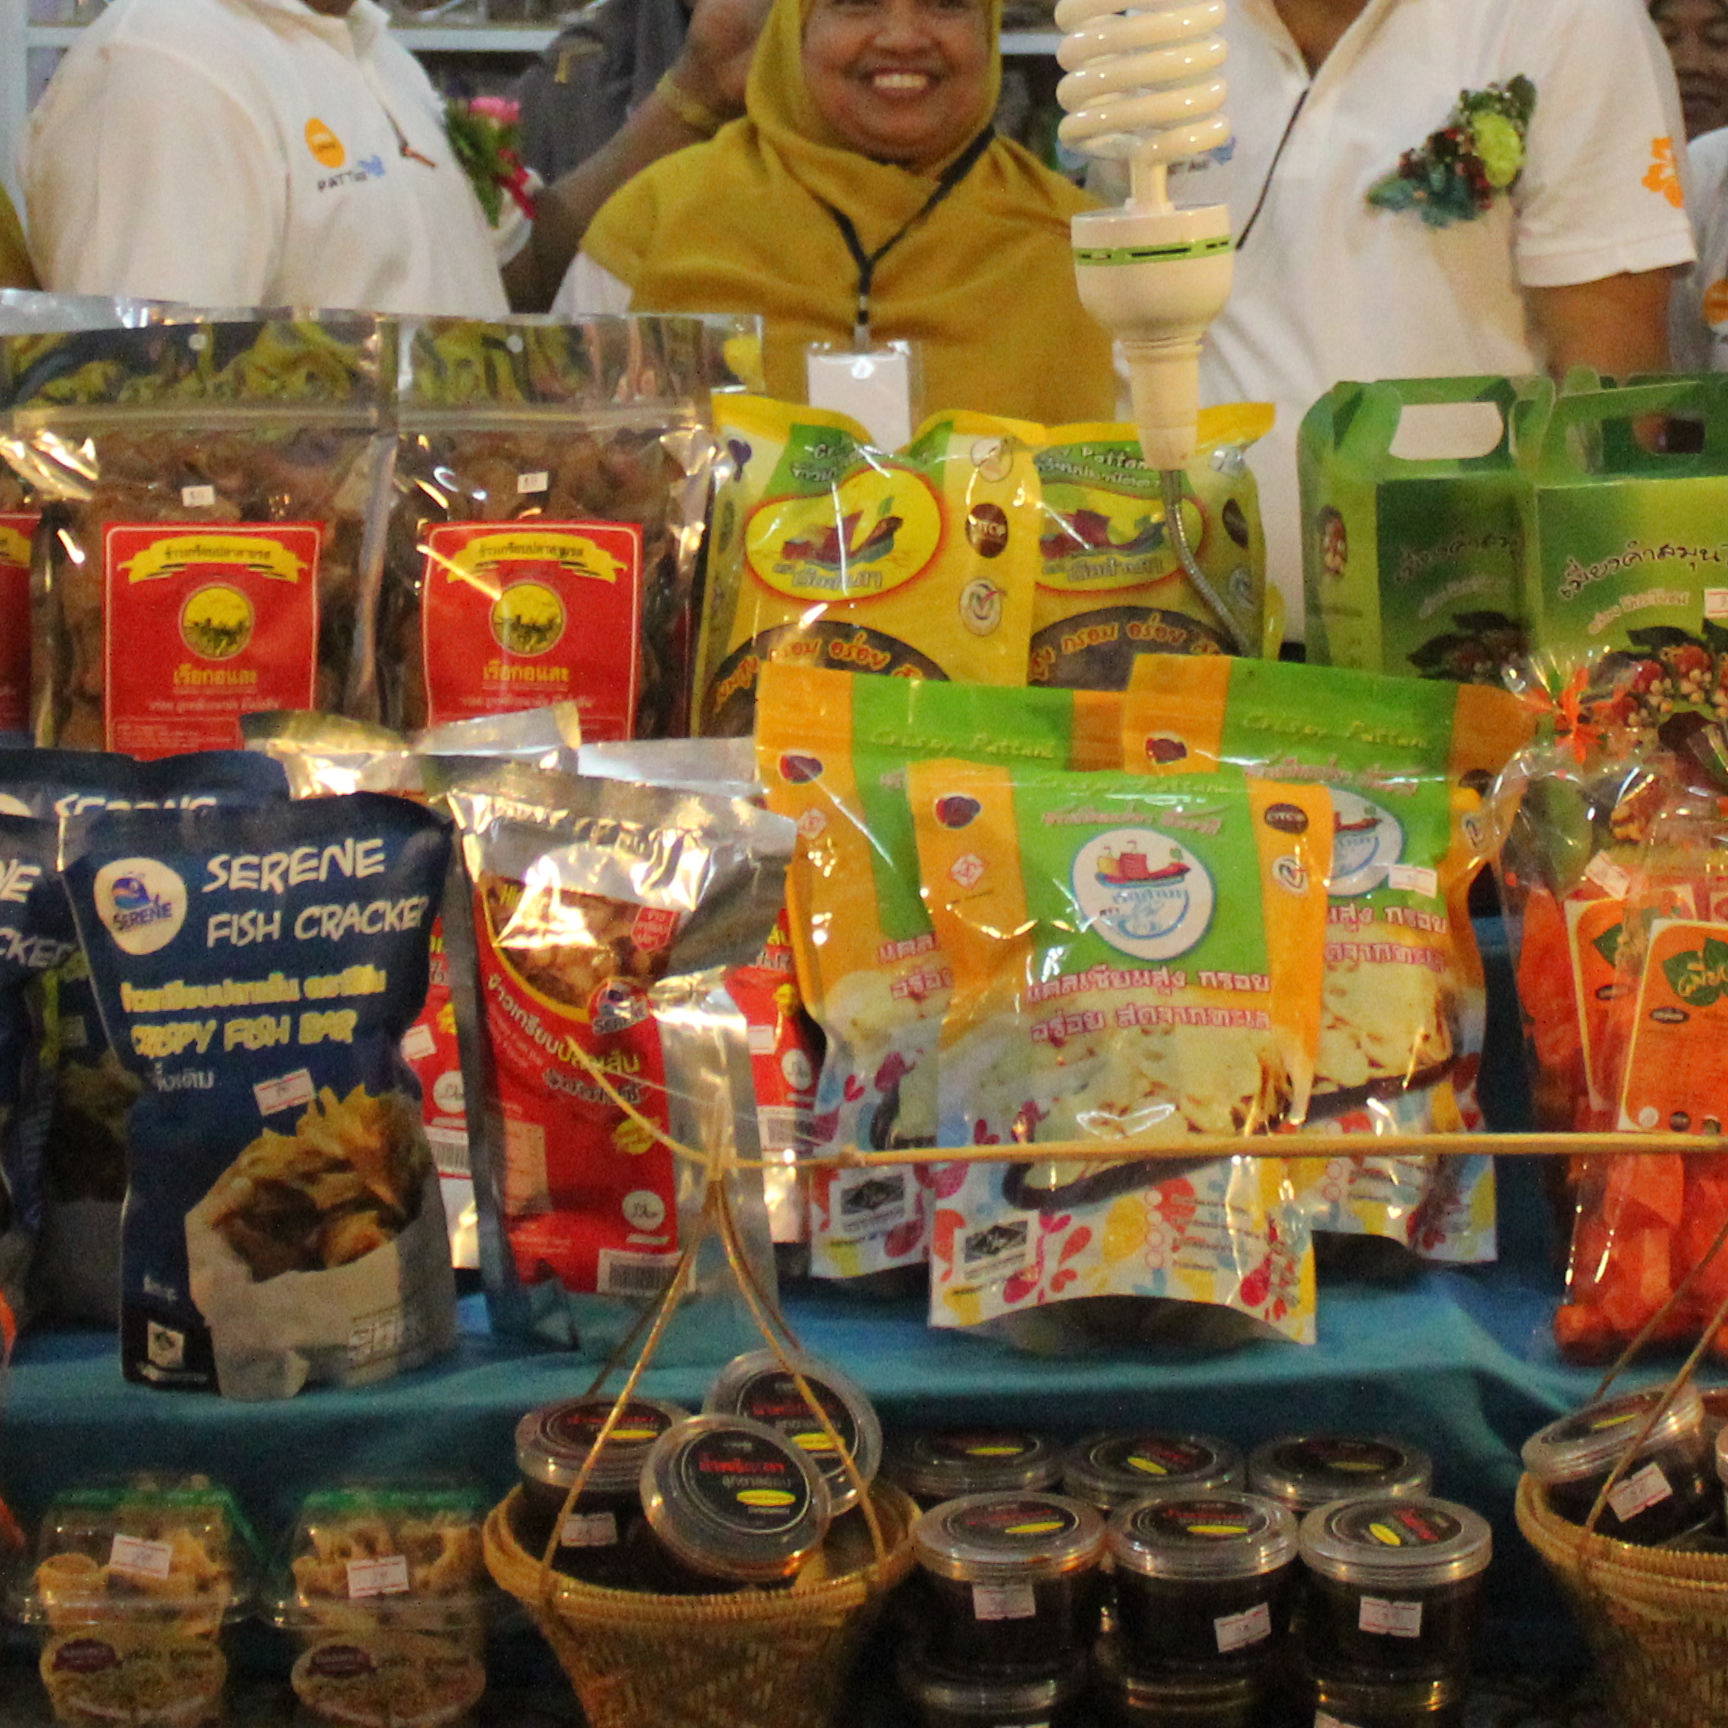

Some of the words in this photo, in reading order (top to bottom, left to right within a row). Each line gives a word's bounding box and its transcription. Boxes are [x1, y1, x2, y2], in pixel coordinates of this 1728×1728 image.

[1061, 623, 1119, 654] กรอบ
[1126, 611, 1187, 643] อร่อย
[201, 836, 386, 894] SERENE
[113, 900, 173, 932] SERENE
[206, 909, 282, 949] FISH
[1384, 905, 1447, 934] กรอบ
[1326, 942, 1446, 973] ดจากทะเล
[1025, 964, 1187, 1000] แคลเซียมสูง
[1197, 968, 1272, 994] กรอบ
[130, 1018, 218, 1059] CRISPY
[223, 1014, 291, 1052] FISH
[298, 1008, 359, 1045] BAR
[1029, 1004, 1106, 1043] อร่อย
[1115, 1002, 1271, 1031] สดจากทะเล
